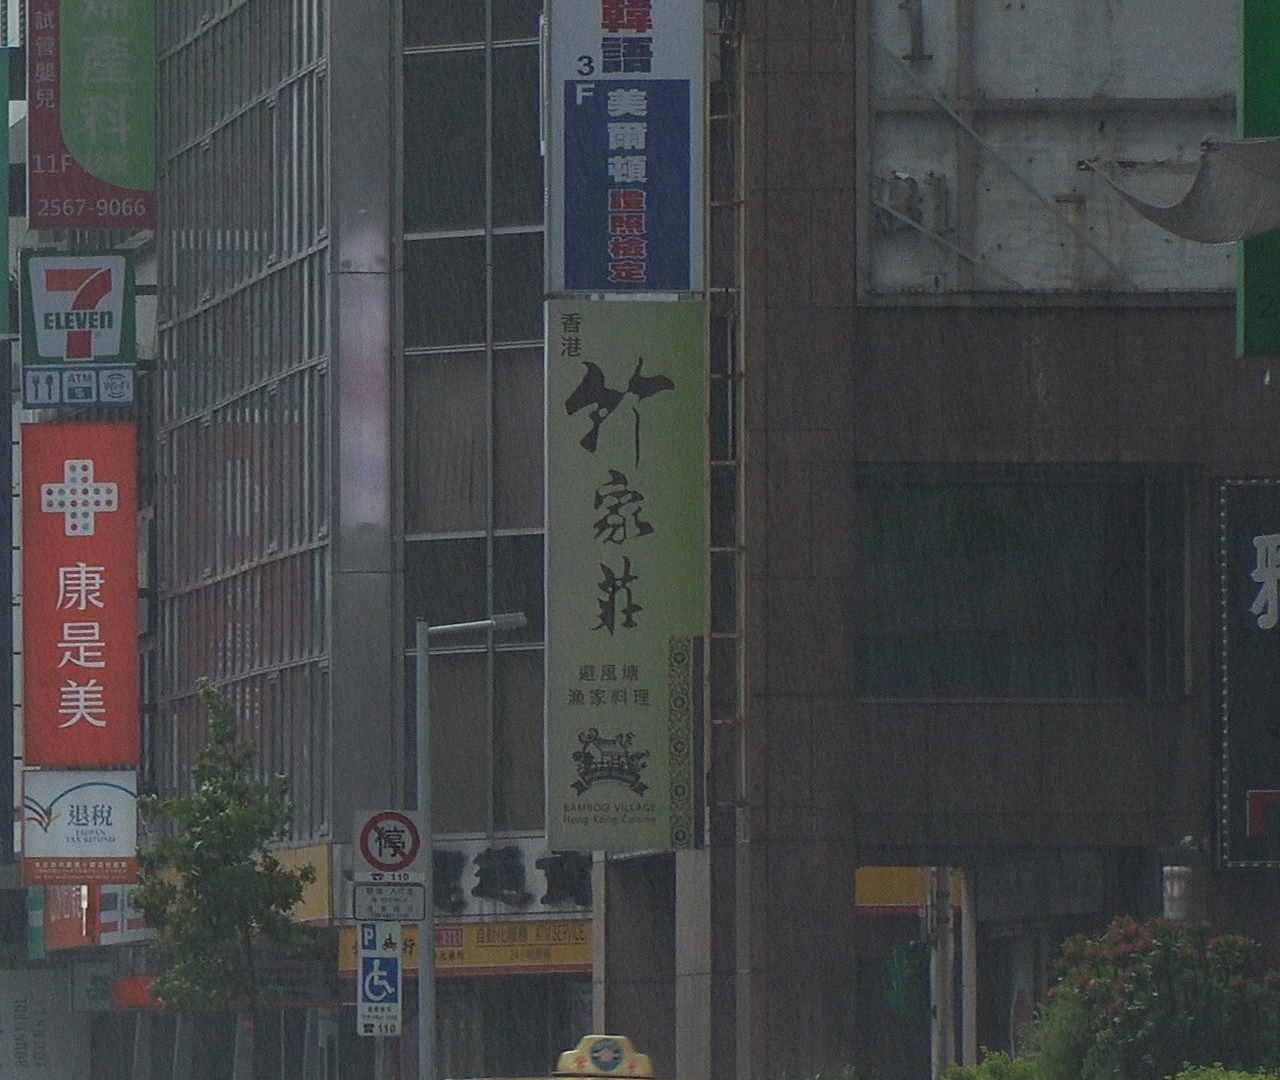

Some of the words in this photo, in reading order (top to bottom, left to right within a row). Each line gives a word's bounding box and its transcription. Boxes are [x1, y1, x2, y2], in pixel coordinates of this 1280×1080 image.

[35, 10, 55, 109] 試管嬰兒
[38, 199, 146, 216] 2567-9066
[561, 312, 582, 357] 香港
[55, 562, 107, 729] 康是美
[568, 688, 650, 706] 漁家料理
[68, 803, 113, 826] 退稅
[563, 803, 609, 813] BAMBOO
[615, 802, 656, 813] VILLAGE
[391, 873, 409, 881] 110
[378, 1023, 396, 1034] 110
